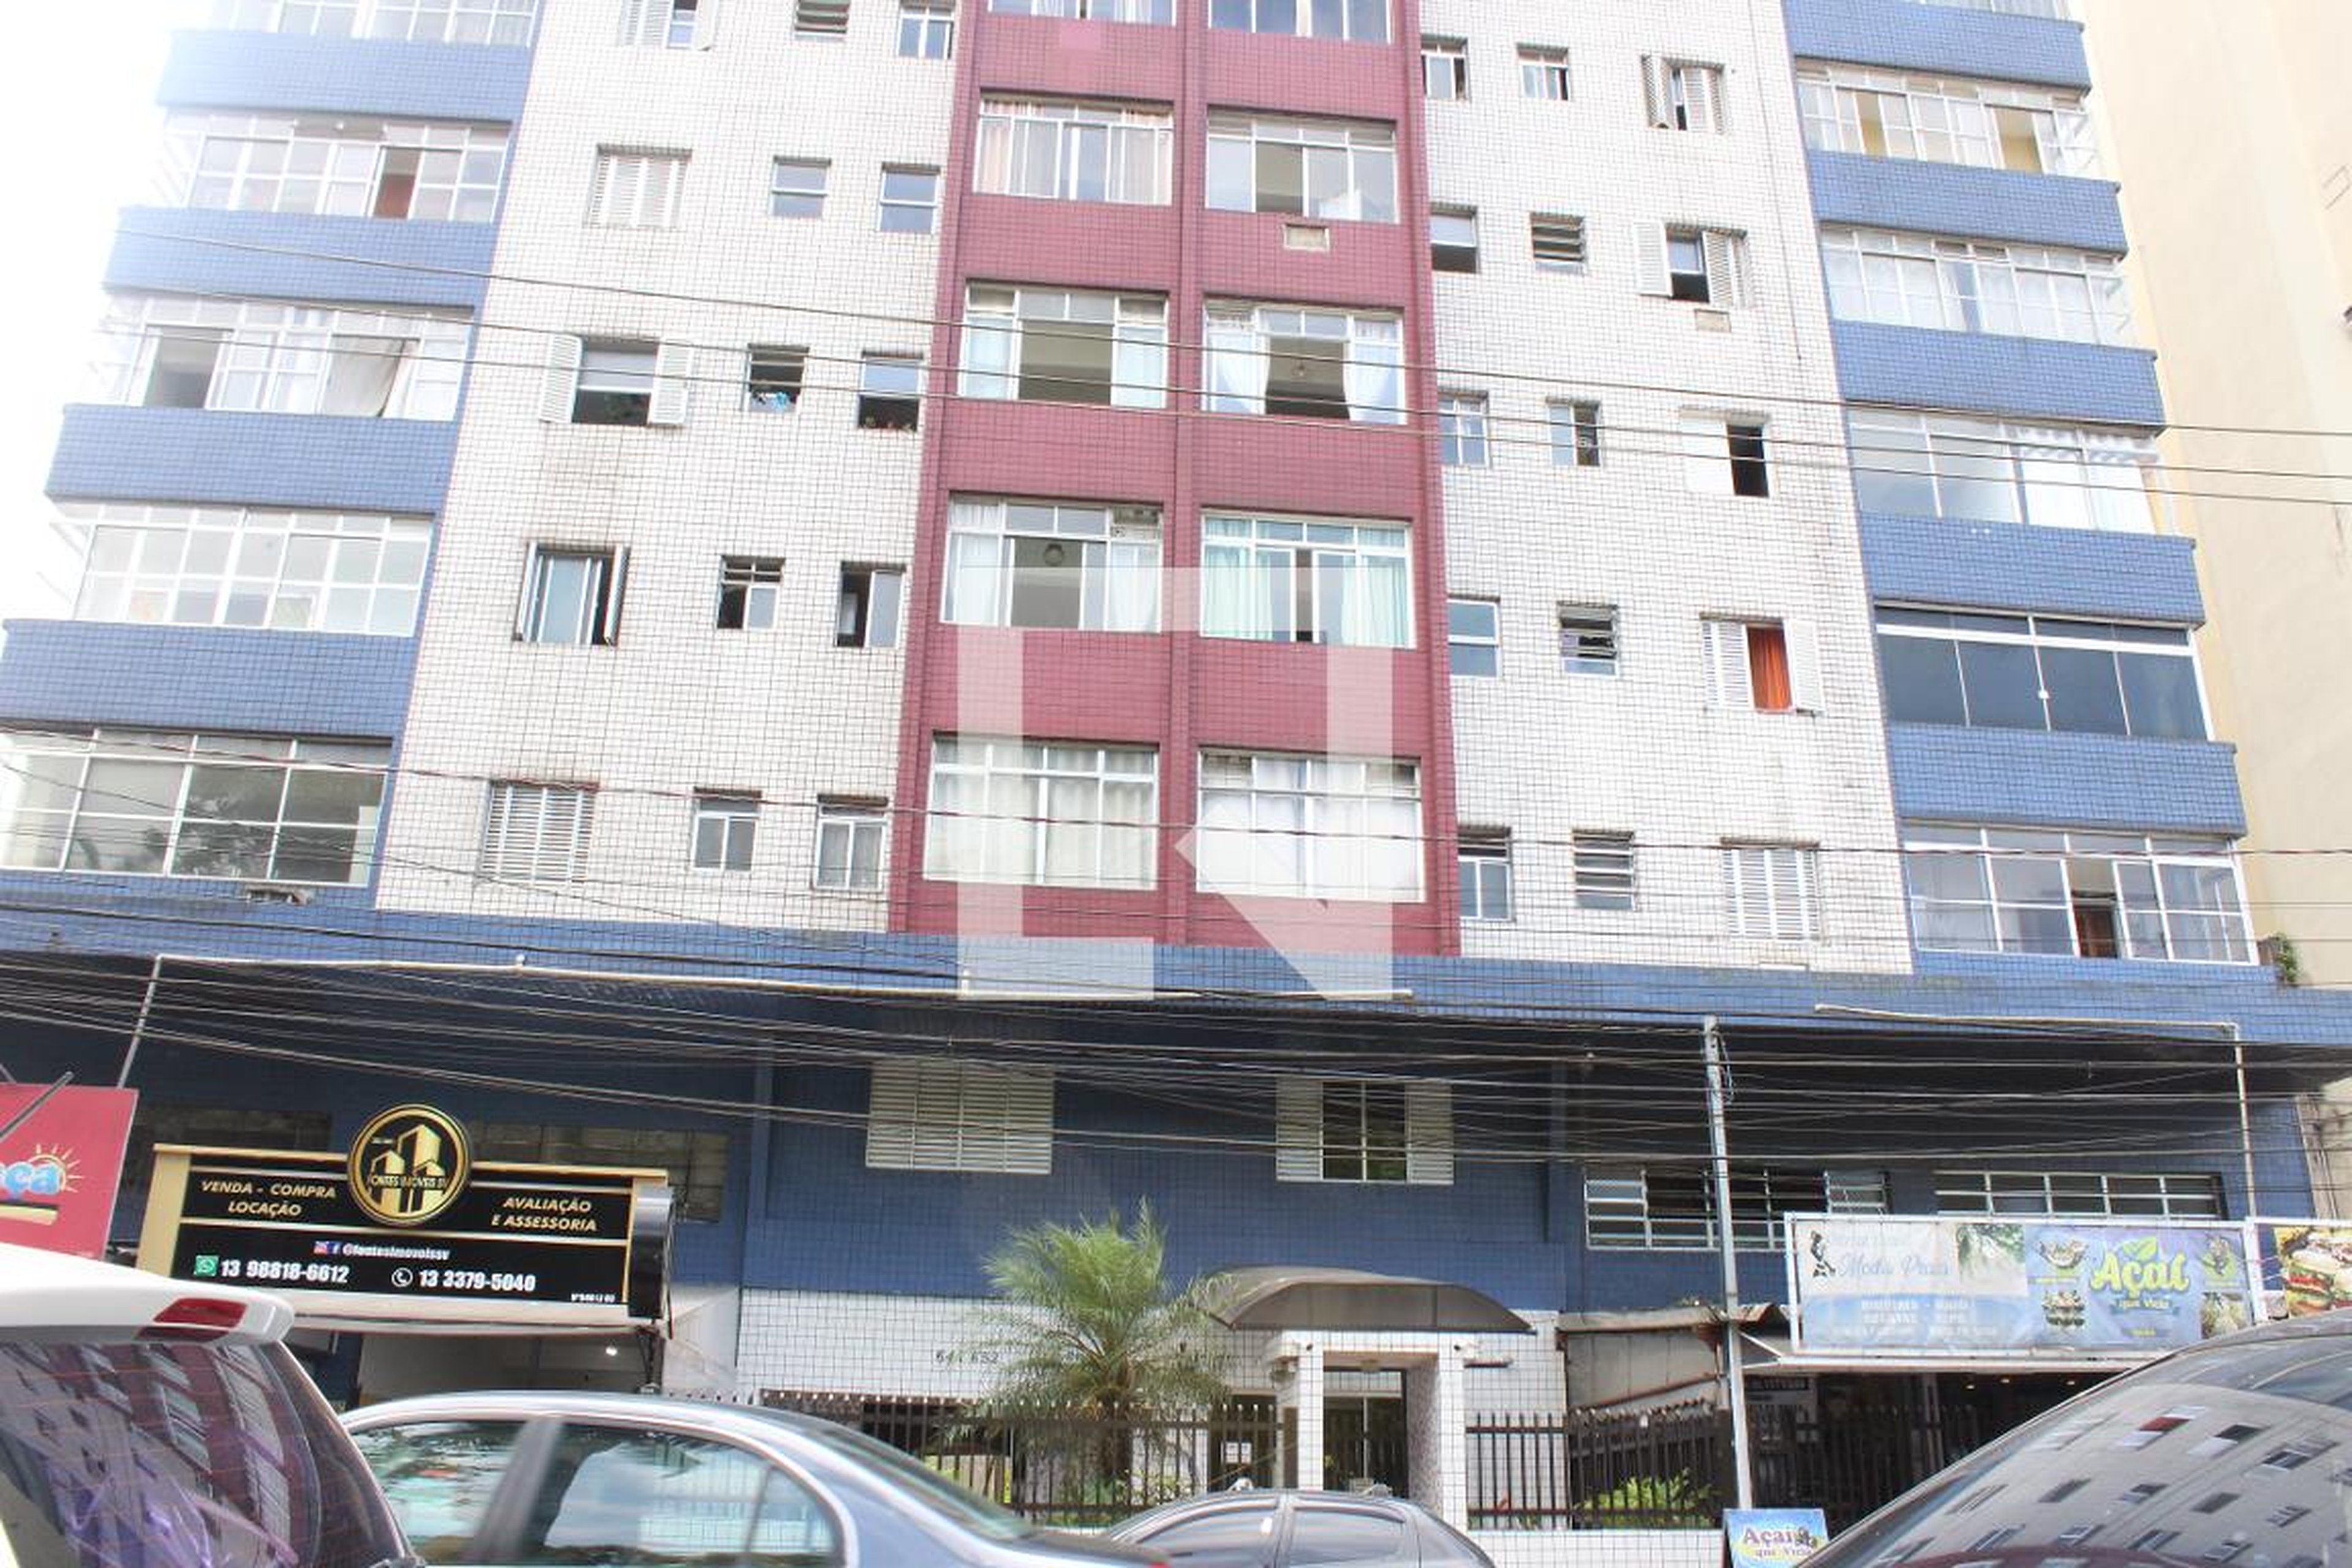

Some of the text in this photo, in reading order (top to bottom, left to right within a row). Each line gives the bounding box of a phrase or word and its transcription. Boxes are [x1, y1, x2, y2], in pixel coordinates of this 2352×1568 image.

[201, 1181, 252, 1194] VENDA
[270, 1184, 336, 1198] COMPRA
[227, 1200, 301, 1218] LOCAÇÃO
[503, 1197, 592, 1214] AVALIAÇÃO
[492, 1215, 597, 1232] E ASSESSORIA
[221, 1259, 241, 1276] 13
[420, 1269, 536, 1292] 13 3379-5040
